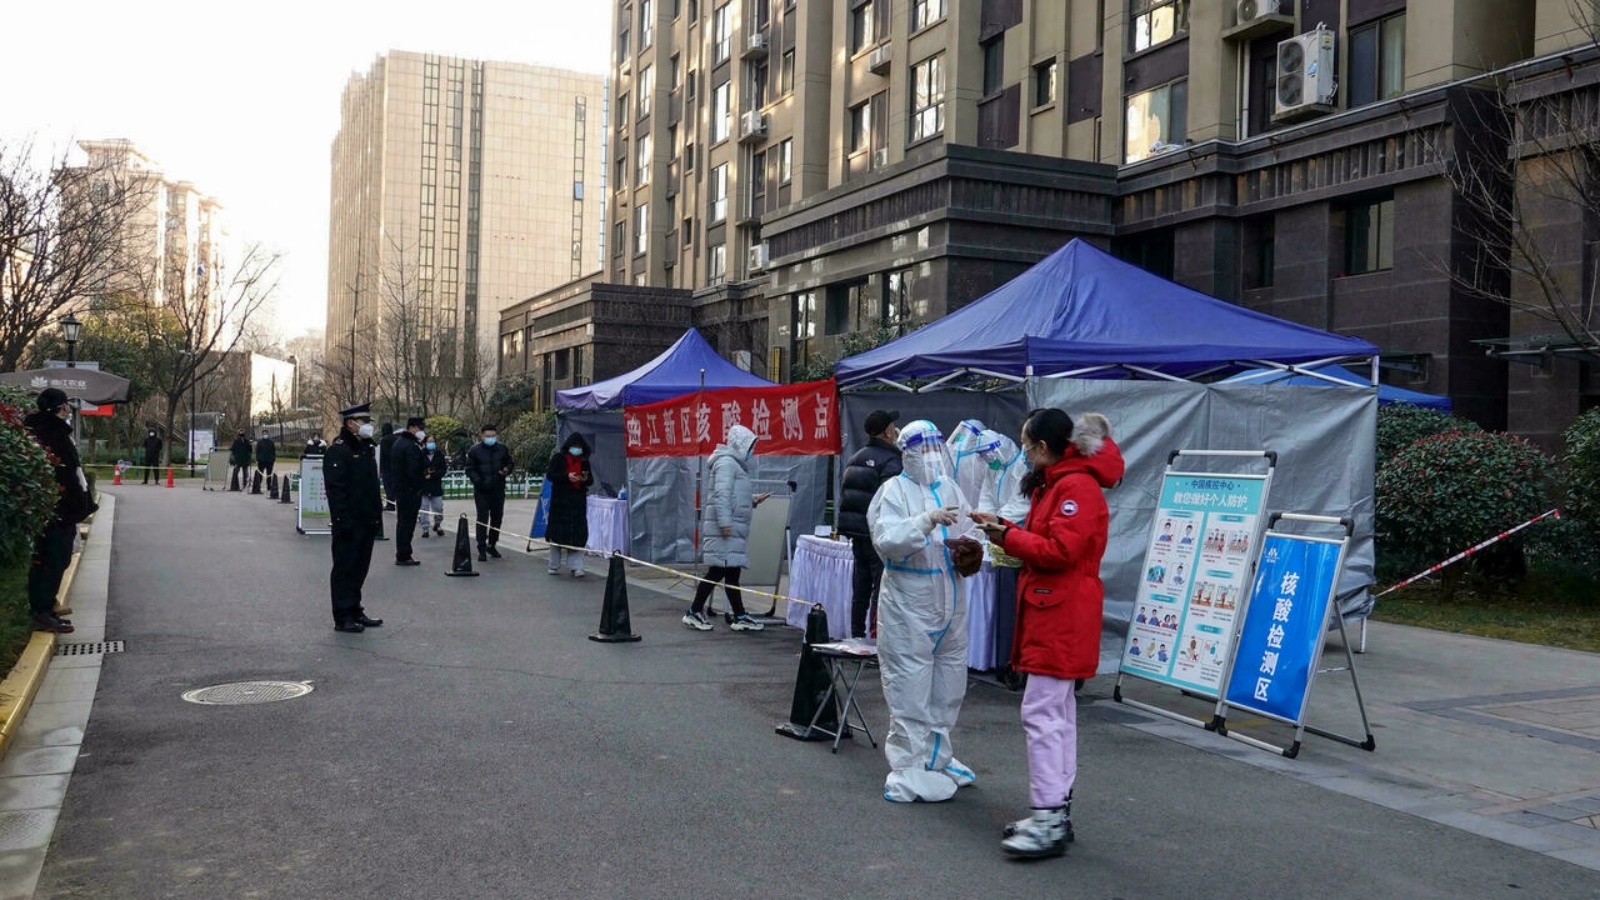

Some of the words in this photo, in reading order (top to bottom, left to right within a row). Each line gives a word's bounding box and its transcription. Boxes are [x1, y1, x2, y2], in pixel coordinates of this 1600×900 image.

[626, 392, 830, 447] 曲江新区核酸检测点
[1254, 571, 1300, 701] 核酸检测区
